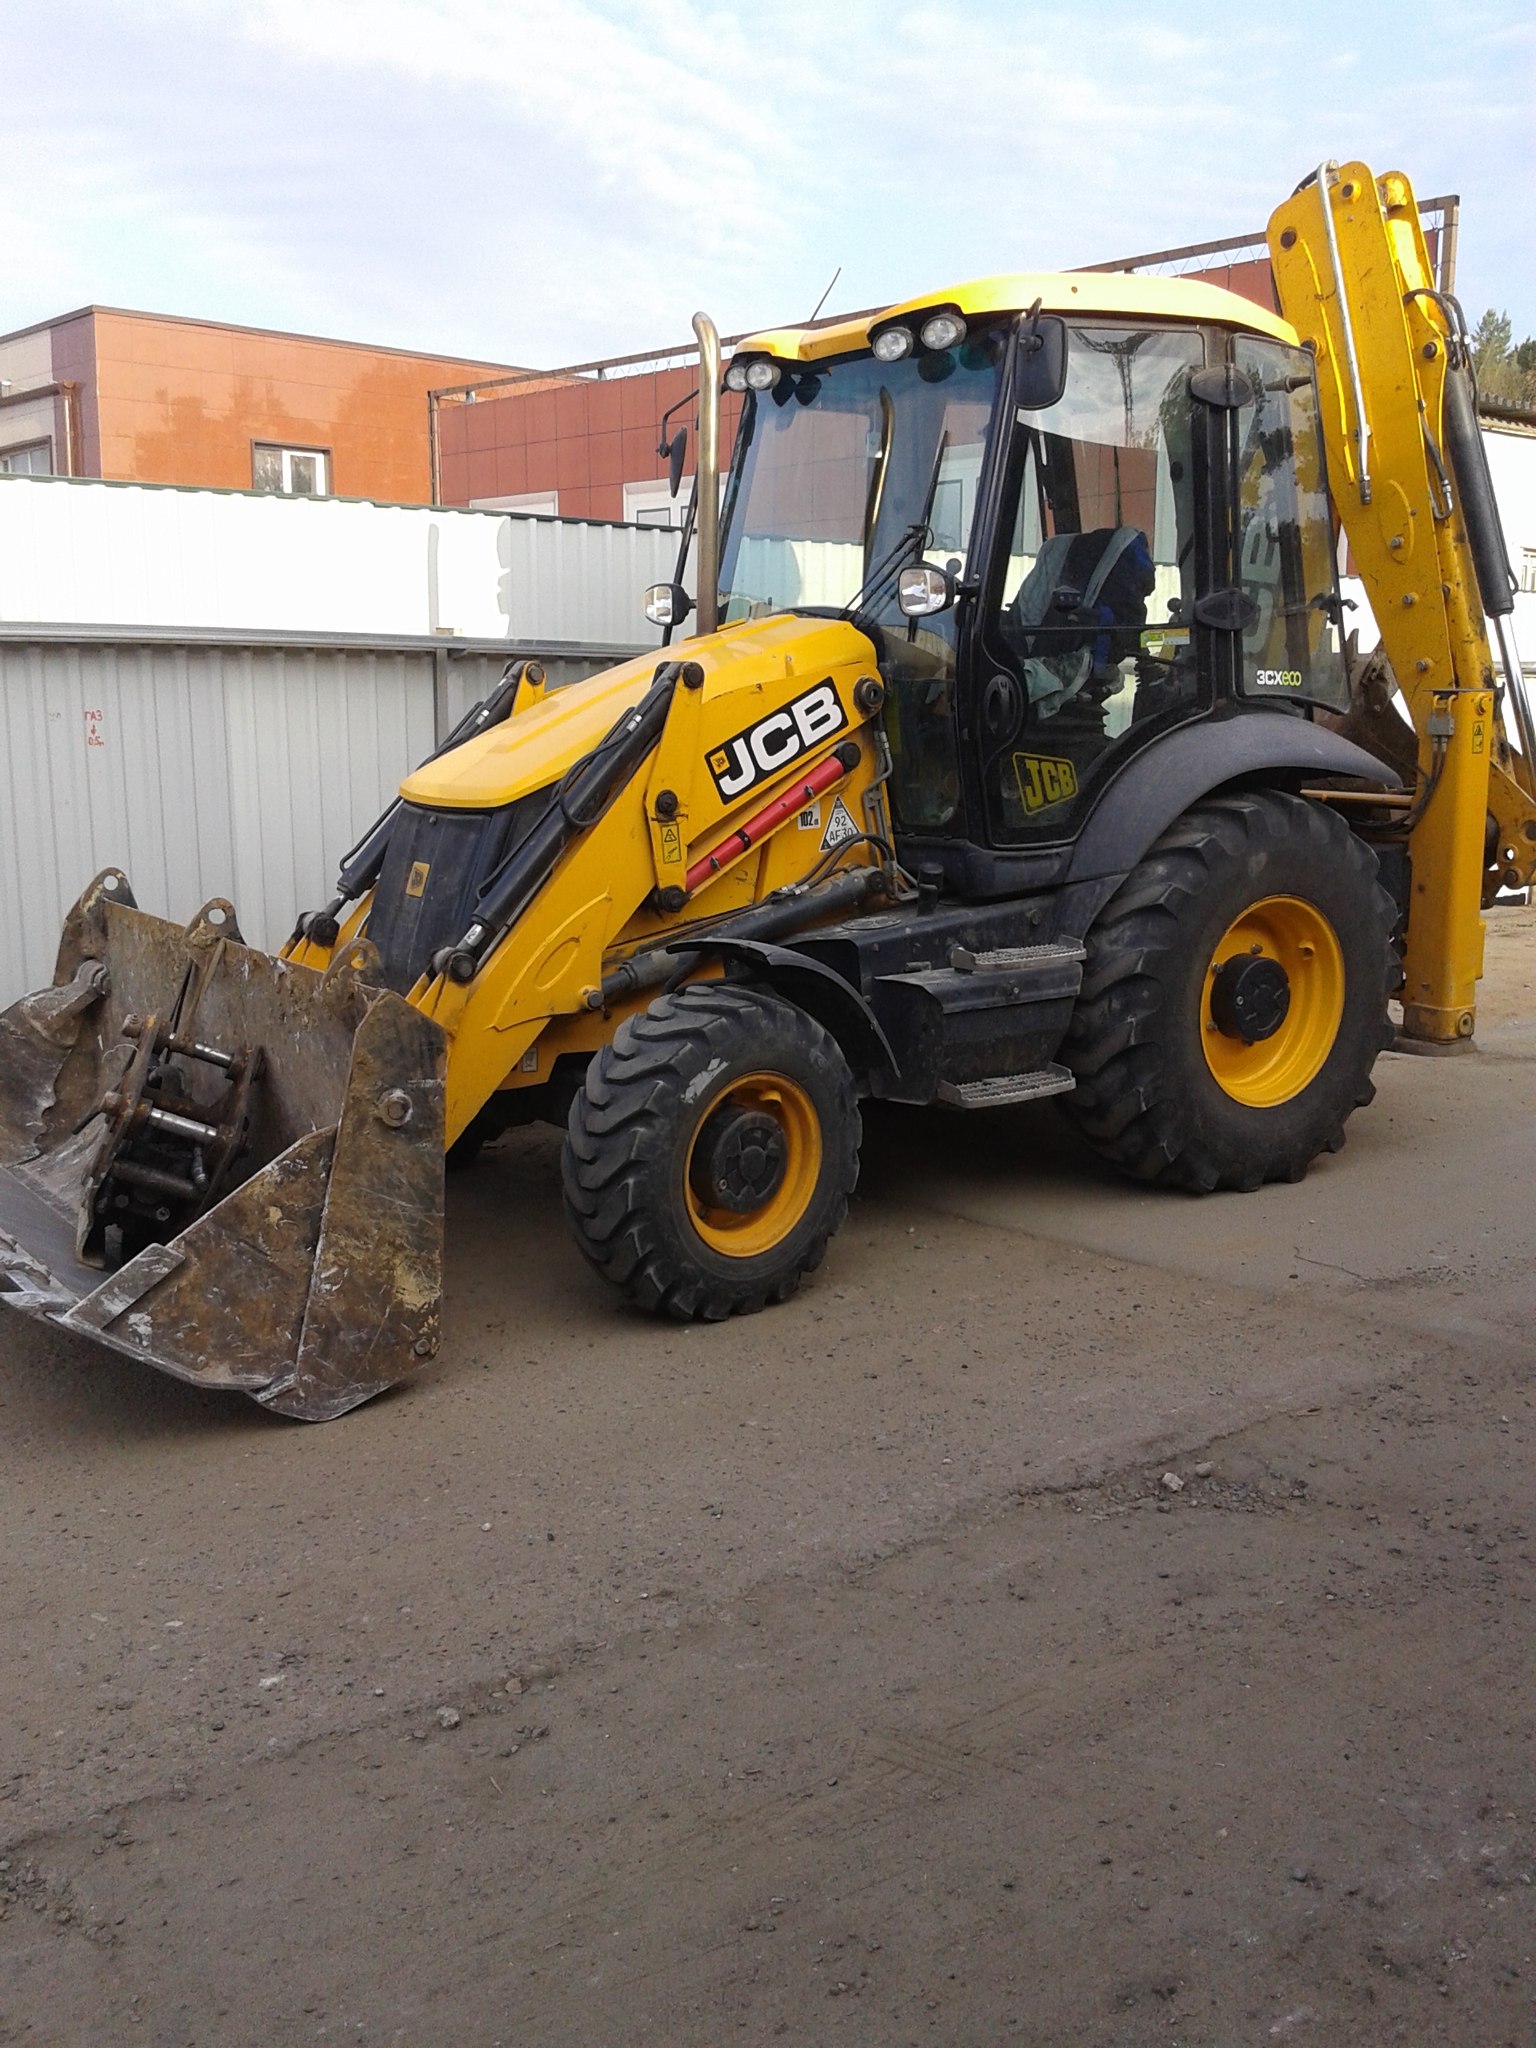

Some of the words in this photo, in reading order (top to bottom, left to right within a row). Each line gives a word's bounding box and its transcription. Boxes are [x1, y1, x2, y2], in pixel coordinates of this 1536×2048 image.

[1256, 669, 1302, 687] 3CXeco
[84, 709, 103, 722] ГАЗ
[718, 686, 843, 796] JCB
[1025, 758, 1075, 807] JCB
[800, 810, 814, 827] 102
[834, 815, 847, 828] 92
